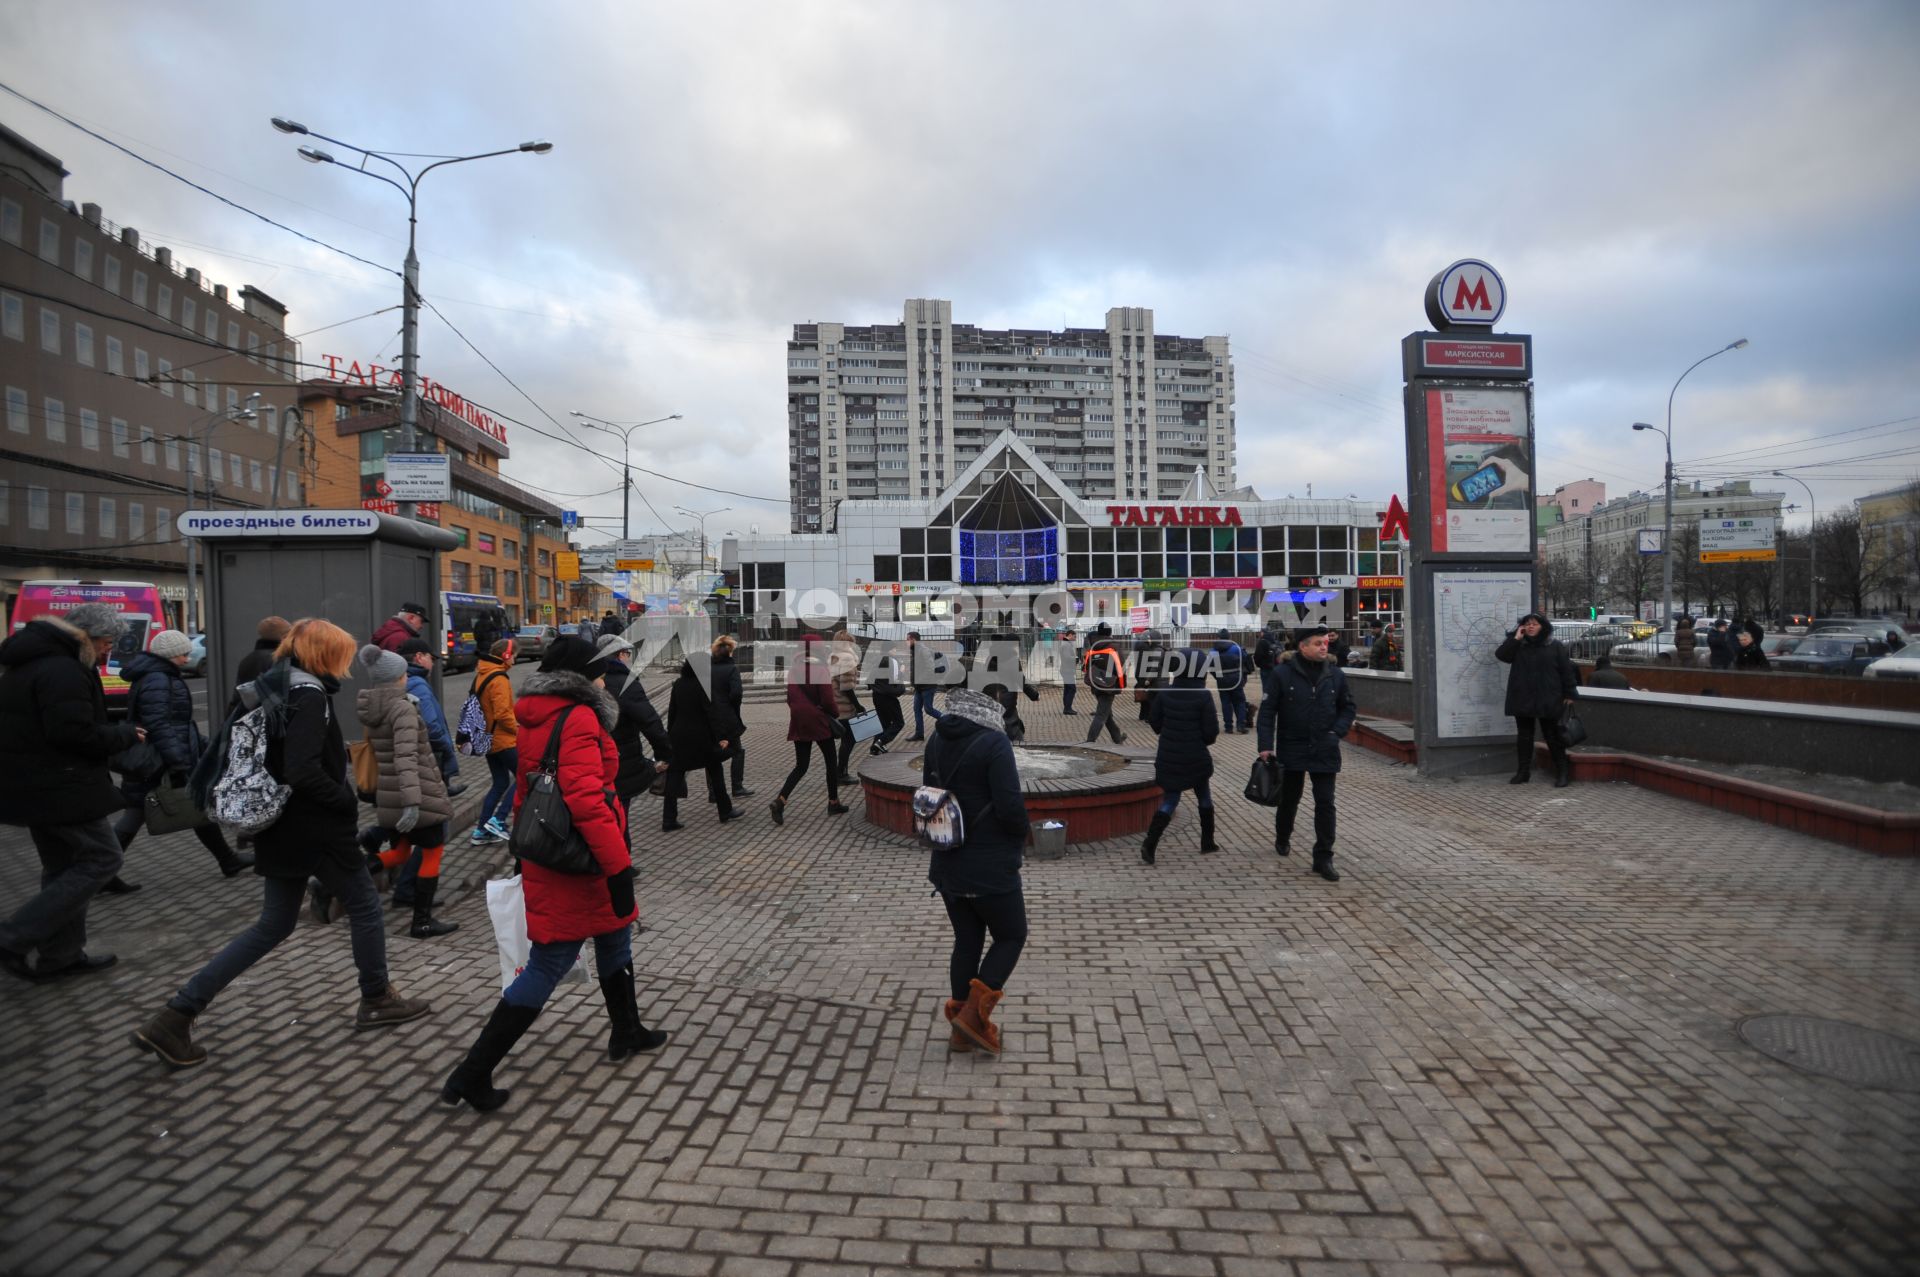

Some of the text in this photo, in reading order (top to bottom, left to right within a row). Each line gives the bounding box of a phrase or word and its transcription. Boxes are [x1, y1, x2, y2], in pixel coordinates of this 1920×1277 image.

[1452, 274, 1492, 312] М
[1444, 350, 1505, 359] МАРКСИСТСКАЯ
[466, 402, 508, 445] ПАССАЖ
[189, 515, 371, 530] проездные билеты
[1106, 506, 1243, 527] ТАГАНКА
